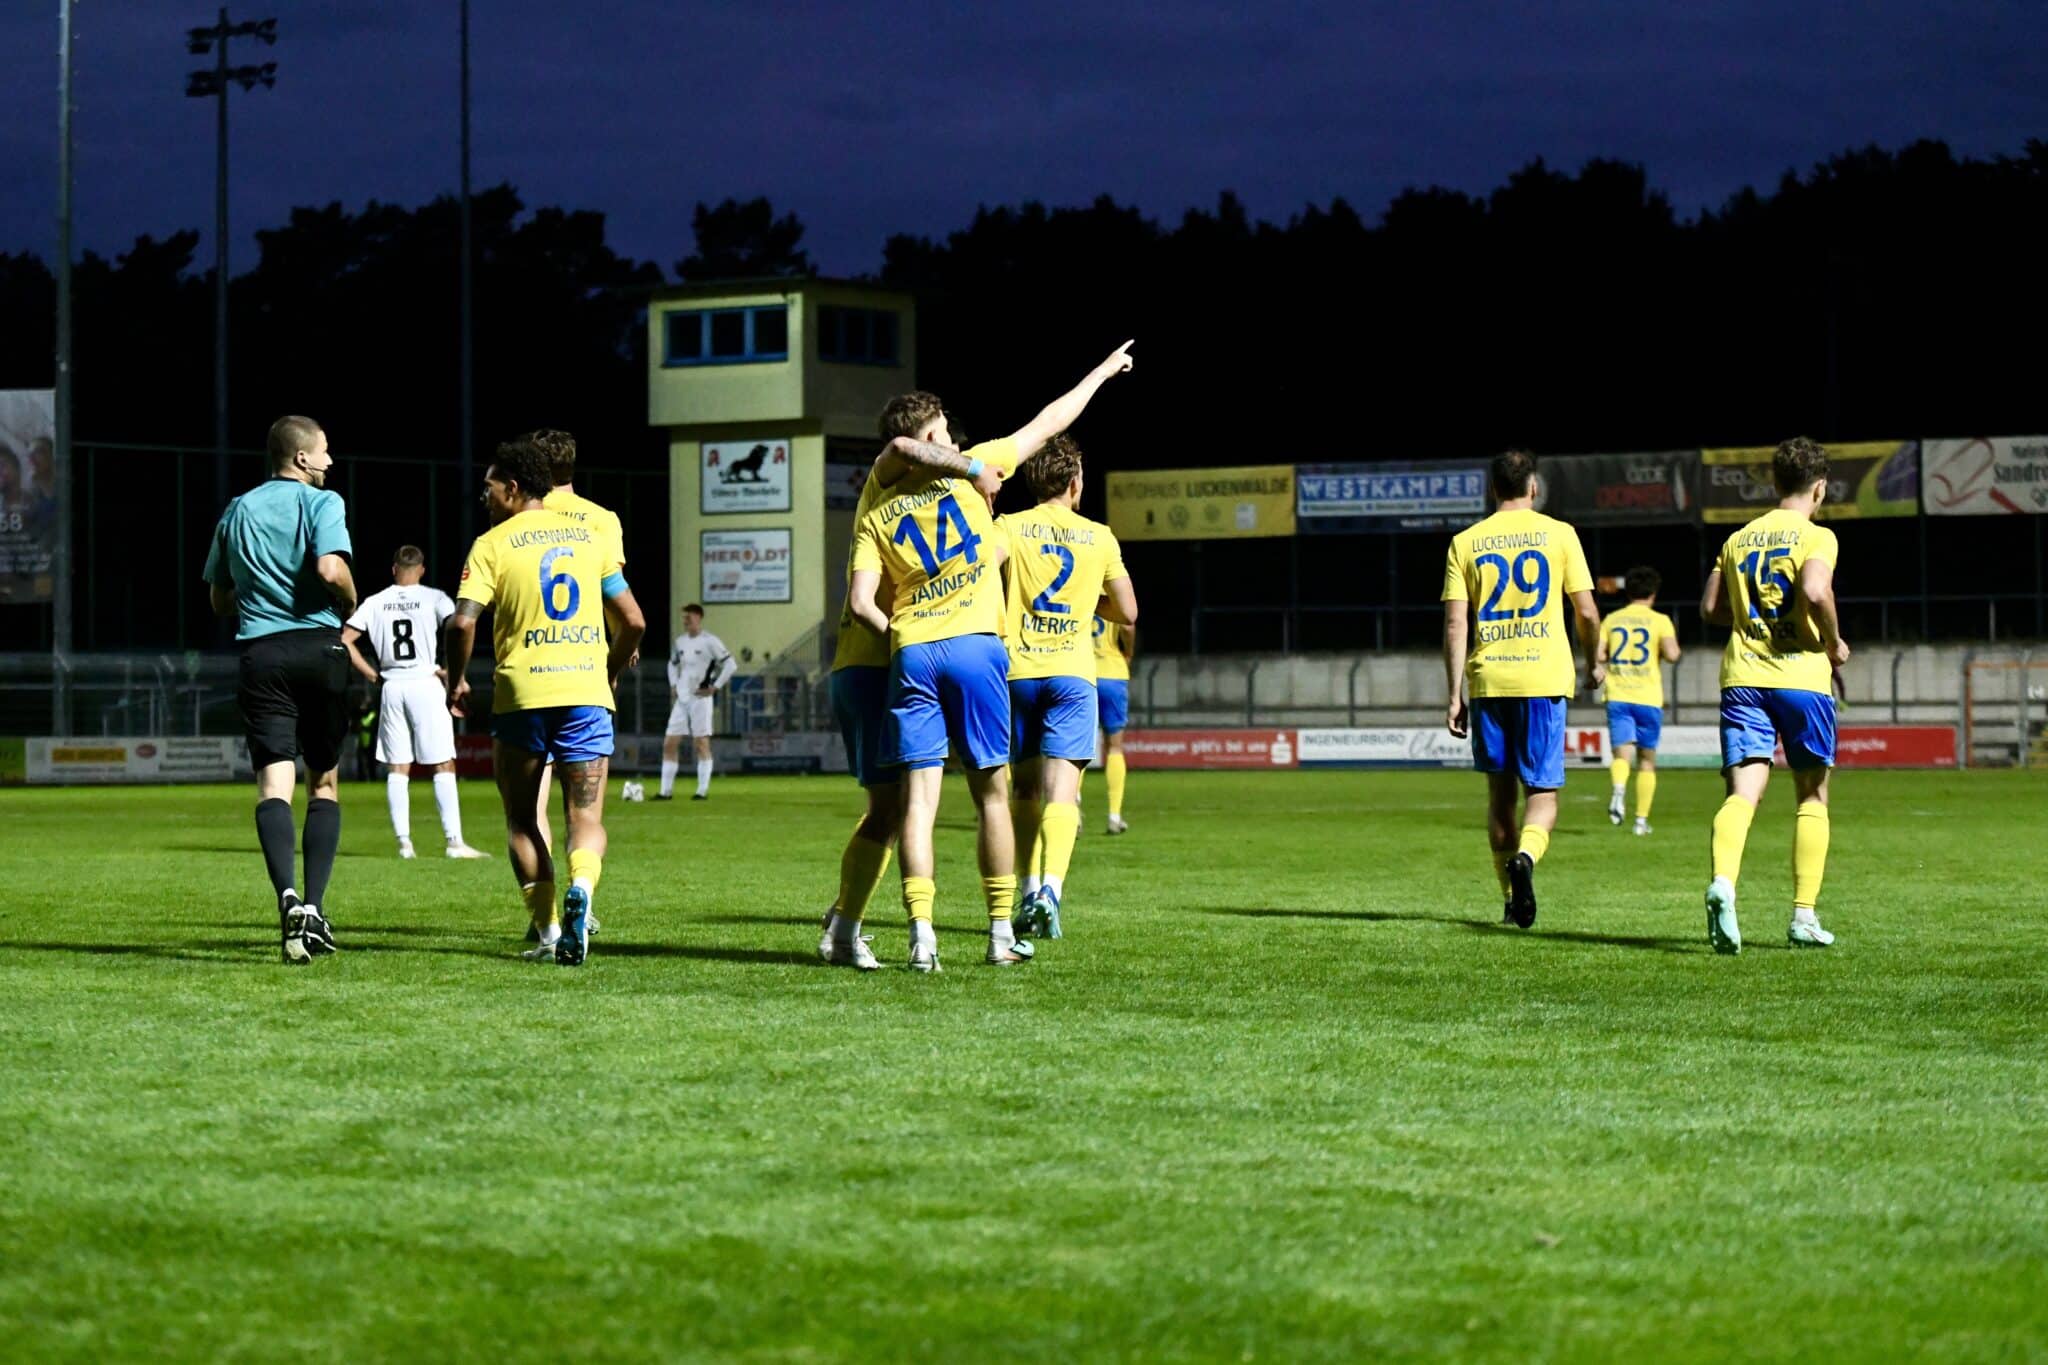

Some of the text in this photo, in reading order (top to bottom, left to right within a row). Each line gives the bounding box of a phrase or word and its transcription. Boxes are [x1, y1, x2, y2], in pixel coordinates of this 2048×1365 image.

[1186, 477, 1289, 498] LUCKENWALDE
[509, 526, 592, 549] LUCKENWALDE
[893, 493, 982, 580] 14
[1472, 532, 1548, 553] LUCKENWALDE
[539, 546, 581, 622] 6
[1032, 543, 1075, 614] 2
[1475, 549, 1551, 622] 29
[1737, 547, 1796, 620] 15
[392, 619, 416, 662] 8
[525, 625, 600, 648] POLLASCH
[1480, 621, 1550, 642] GOLLNACK
[1610, 626, 1650, 666] 23
